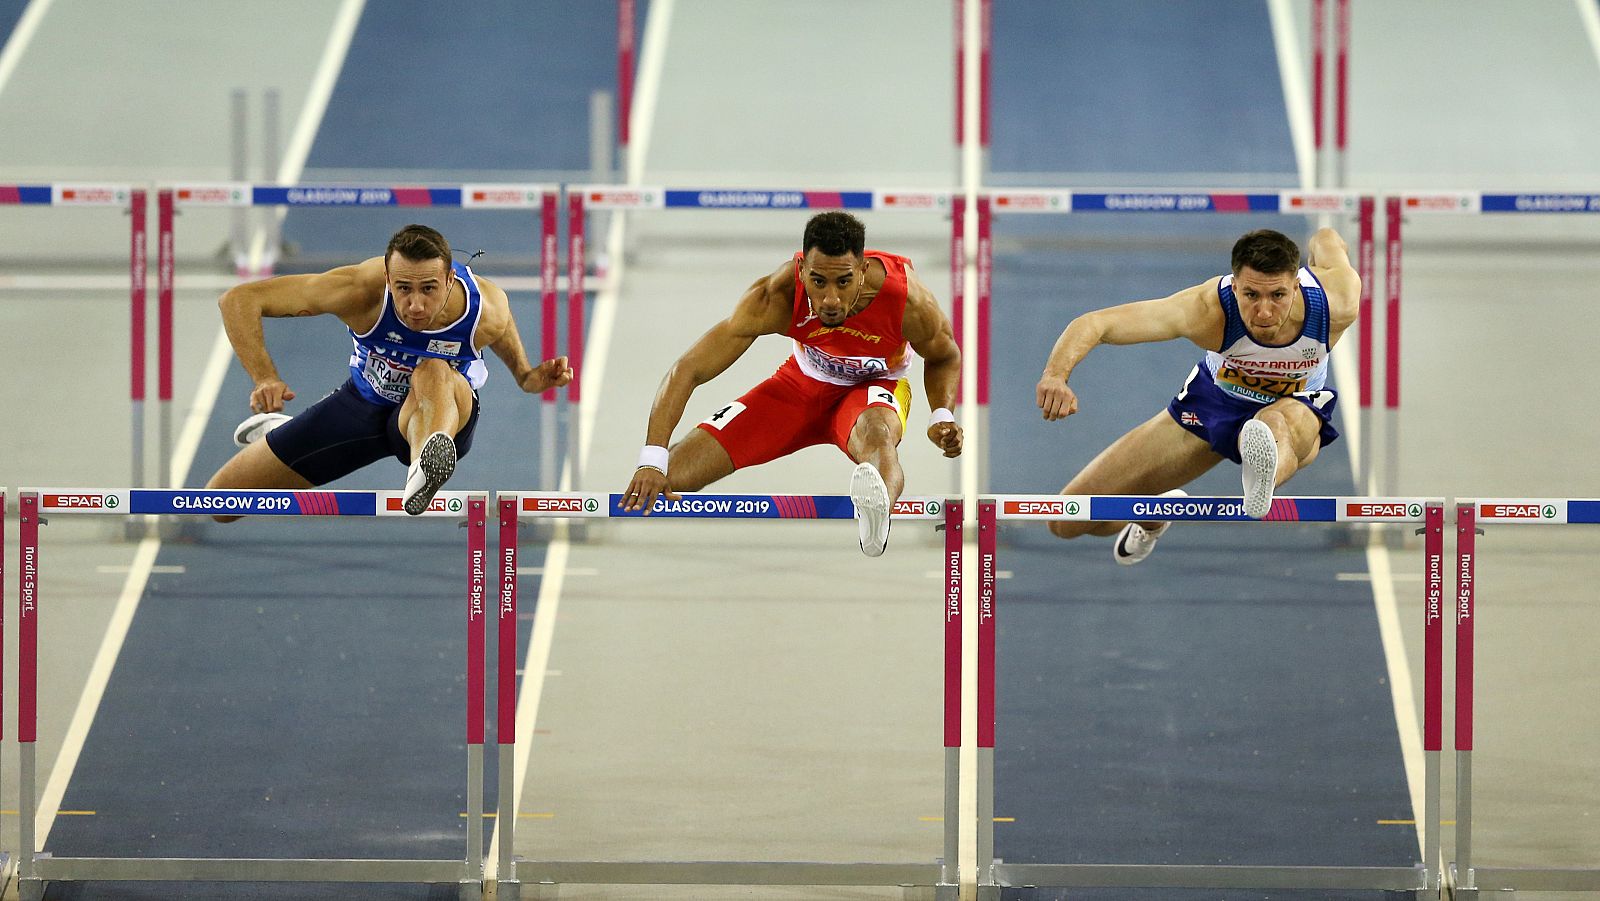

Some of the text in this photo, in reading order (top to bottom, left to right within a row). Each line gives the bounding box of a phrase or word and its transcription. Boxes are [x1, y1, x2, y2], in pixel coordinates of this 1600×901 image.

[287, 189, 392, 204] GLASGOW 2019
[698, 191, 804, 207] GLASGOW 2019
[1105, 194, 1210, 210] GLASGOW 2019
[370, 358, 412, 384] TRAJK
[1269, 358, 1319, 370] BRITAIN
[1223, 368, 1301, 398] POZZI
[1236, 387, 1255, 398] RUN
[1256, 391, 1276, 403] CLEA
[57, 496, 102, 508] SPAR
[172, 496, 291, 511] GLASGOW 2019
[537, 499, 582, 511] SPAR
[652, 500, 770, 514] GLASGOW 2019
[1018, 502, 1063, 514] SPAR
[1132, 503, 1214, 517] GLASGOW
[1361, 505, 1406, 517] SPAR
[1494, 506, 1540, 518] SPAR
[22, 581, 35, 612] Sport
[470, 585, 483, 616] Sport
[501, 583, 514, 613] Sport
[948, 586, 960, 616] Sport
[981, 589, 993, 619] Sport
[1428, 589, 1440, 619] Sport
[1458, 589, 1471, 619] Sport
